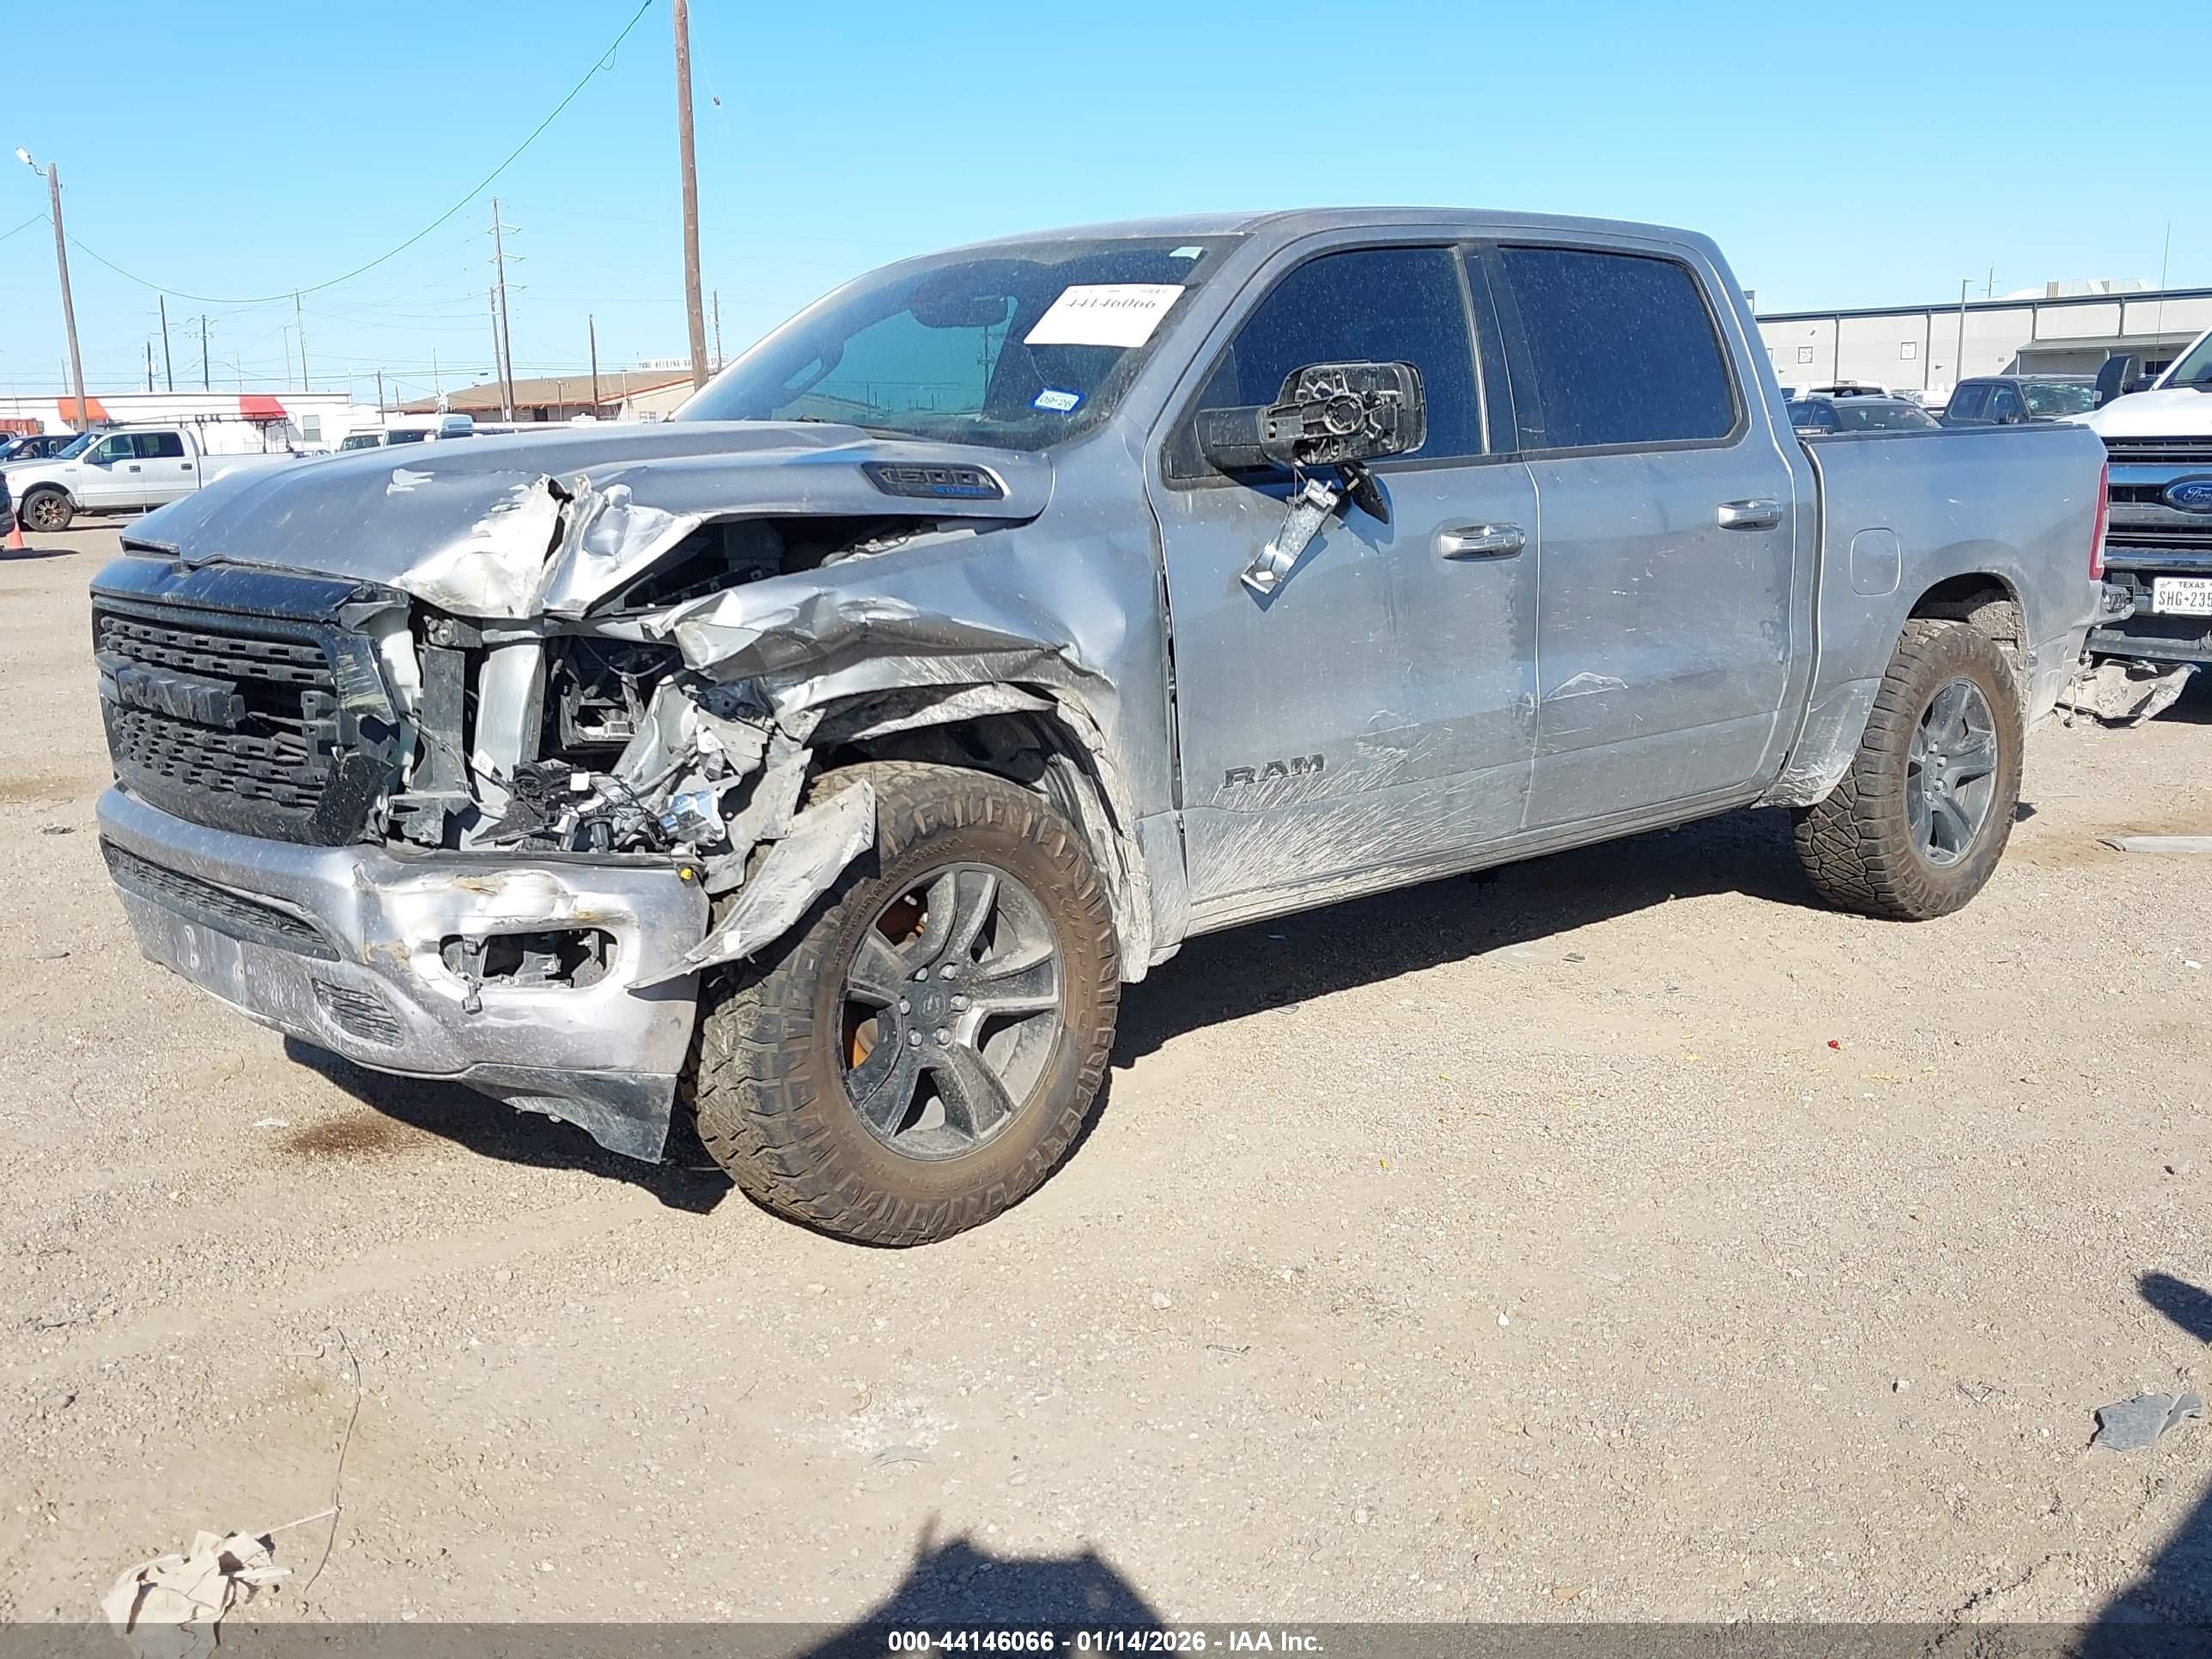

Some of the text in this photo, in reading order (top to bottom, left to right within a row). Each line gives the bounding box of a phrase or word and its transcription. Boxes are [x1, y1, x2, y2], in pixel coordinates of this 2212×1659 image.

[878, 467, 981, 486] 1500
[2183, 486, 2212, 502] For
[2179, 580, 2206, 589] TEXAS
[1223, 753, 1325, 788] RAM
